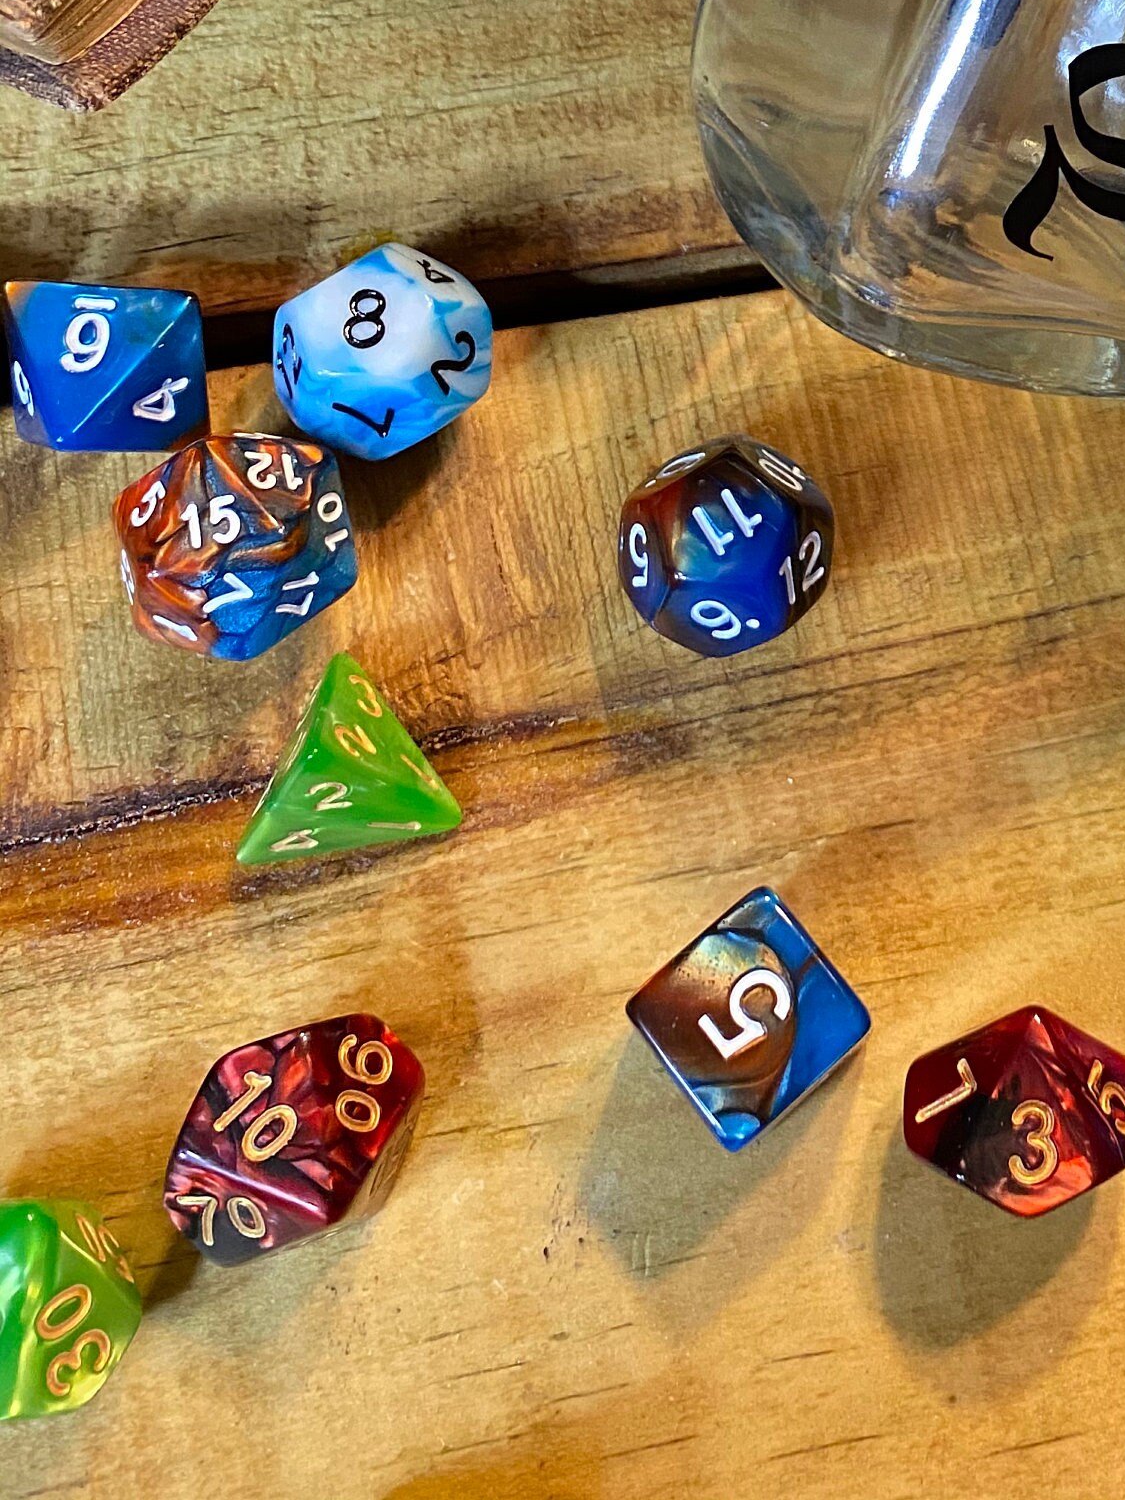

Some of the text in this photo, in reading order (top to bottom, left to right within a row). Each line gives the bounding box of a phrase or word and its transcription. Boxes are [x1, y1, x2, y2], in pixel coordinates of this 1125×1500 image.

[343, 288, 387, 350] 8
[430, 330, 476, 396] 2
[132, 376, 190, 423] 4
[332, 402, 396, 439] 7
[242, 450, 304, 490] 12
[130, 480, 167, 528] 5
[180, 494, 241, 549] 15
[316, 492, 349, 552] 10
[692, 488, 763, 557] 11
[629, 523, 649, 588] 5
[779, 530, 825, 605] 12
[202, 572, 254, 614] 7
[348, 674, 383, 718] 3
[334, 723, 377, 758] 2
[304, 781, 353, 812] 2
[269, 828, 319, 853] 4
[697, 968, 793, 1060] 5
[213, 1070, 299, 1163] 10
[1007, 1100, 1058, 1186] 3
[177, 1194, 267, 1247] 70
[36, 1283, 112, 1397] 30
